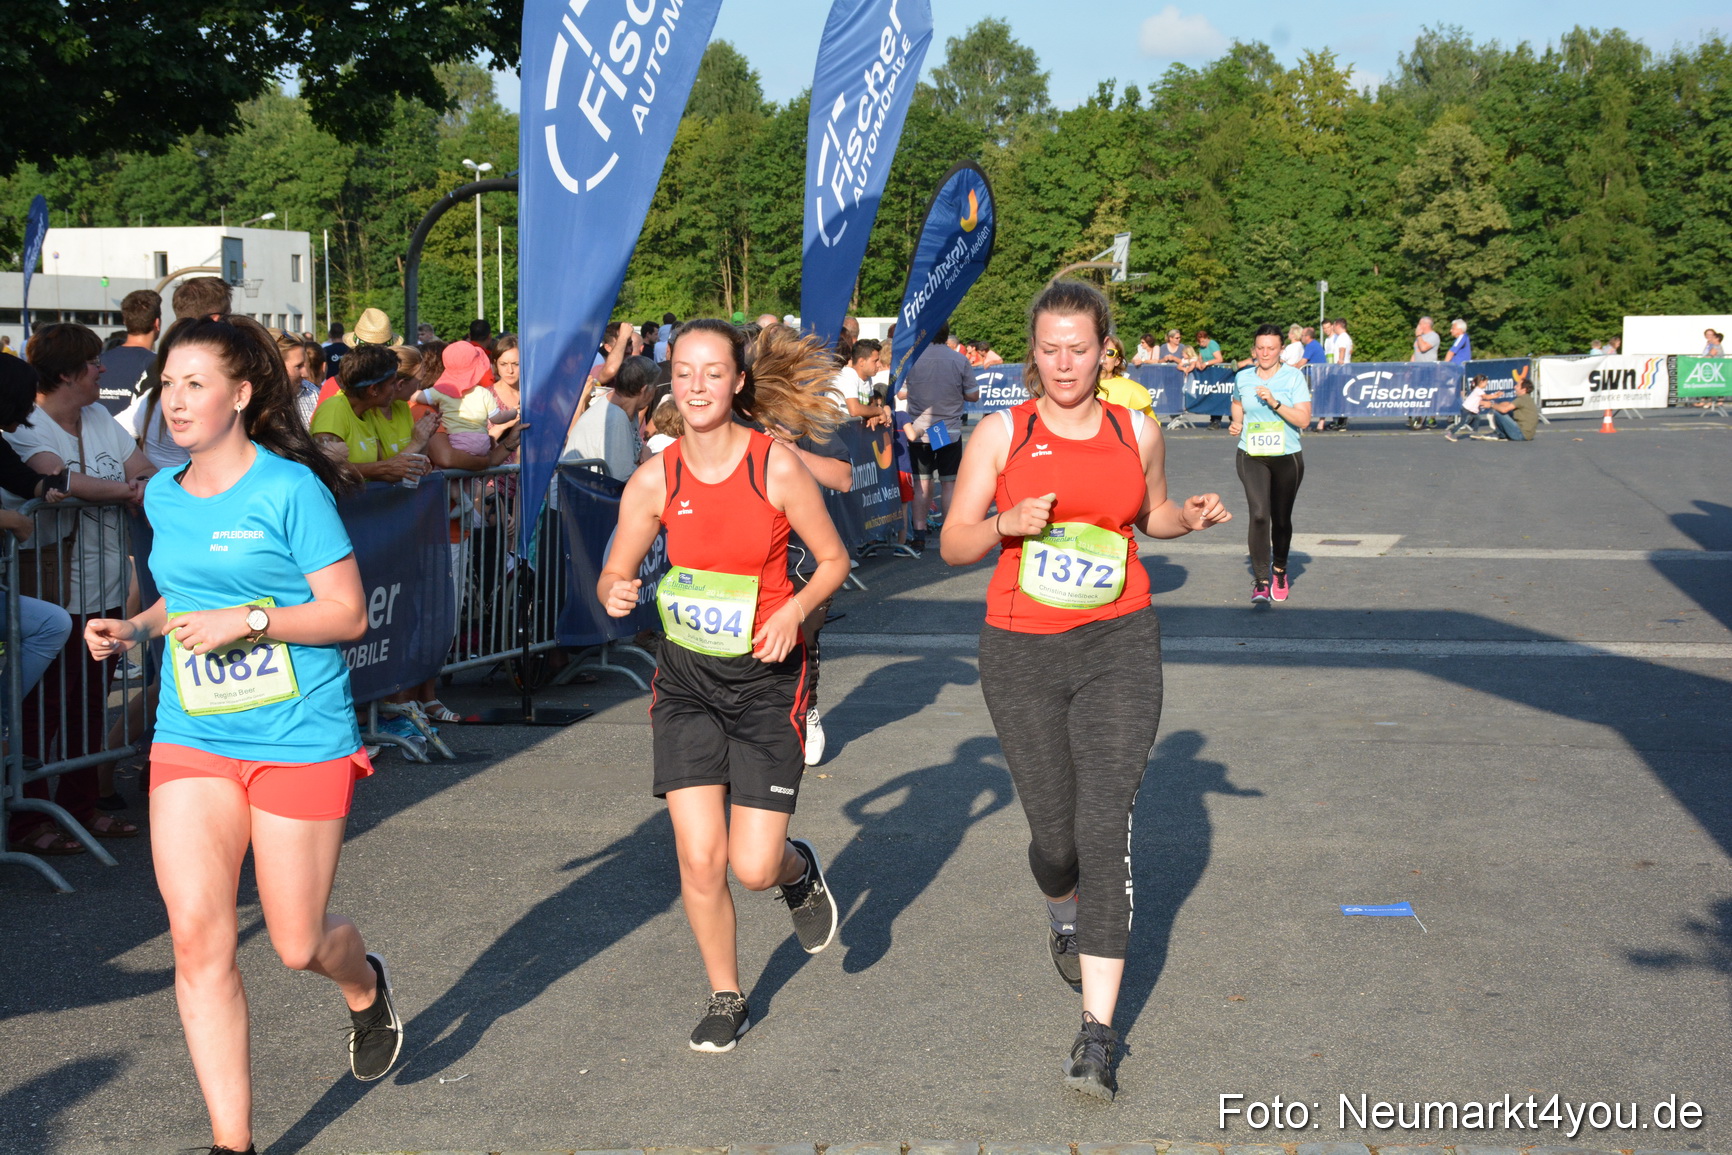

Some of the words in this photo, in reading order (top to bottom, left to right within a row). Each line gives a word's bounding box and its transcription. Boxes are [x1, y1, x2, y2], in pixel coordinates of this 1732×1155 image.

[831, 0, 902, 212] Fischer
[1588, 368, 1636, 392] swn
[1685, 362, 1726, 383] AOK
[978, 383, 1031, 398] Fische
[1191, 379, 1235, 396] Frischm
[1359, 384, 1438, 400] Fischer
[1366, 401, 1431, 409] AUTOMOBILE
[1250, 434, 1281, 446] 1502
[219, 530, 264, 539] PFLEIDERER
[210, 544, 229, 552] Nina
[1034, 549, 1114, 589] 1372
[667, 601, 742, 638] 1394
[342, 638, 390, 671] OBILE
[184, 643, 279, 687] 1082
[238, 687, 256, 696] Beer
